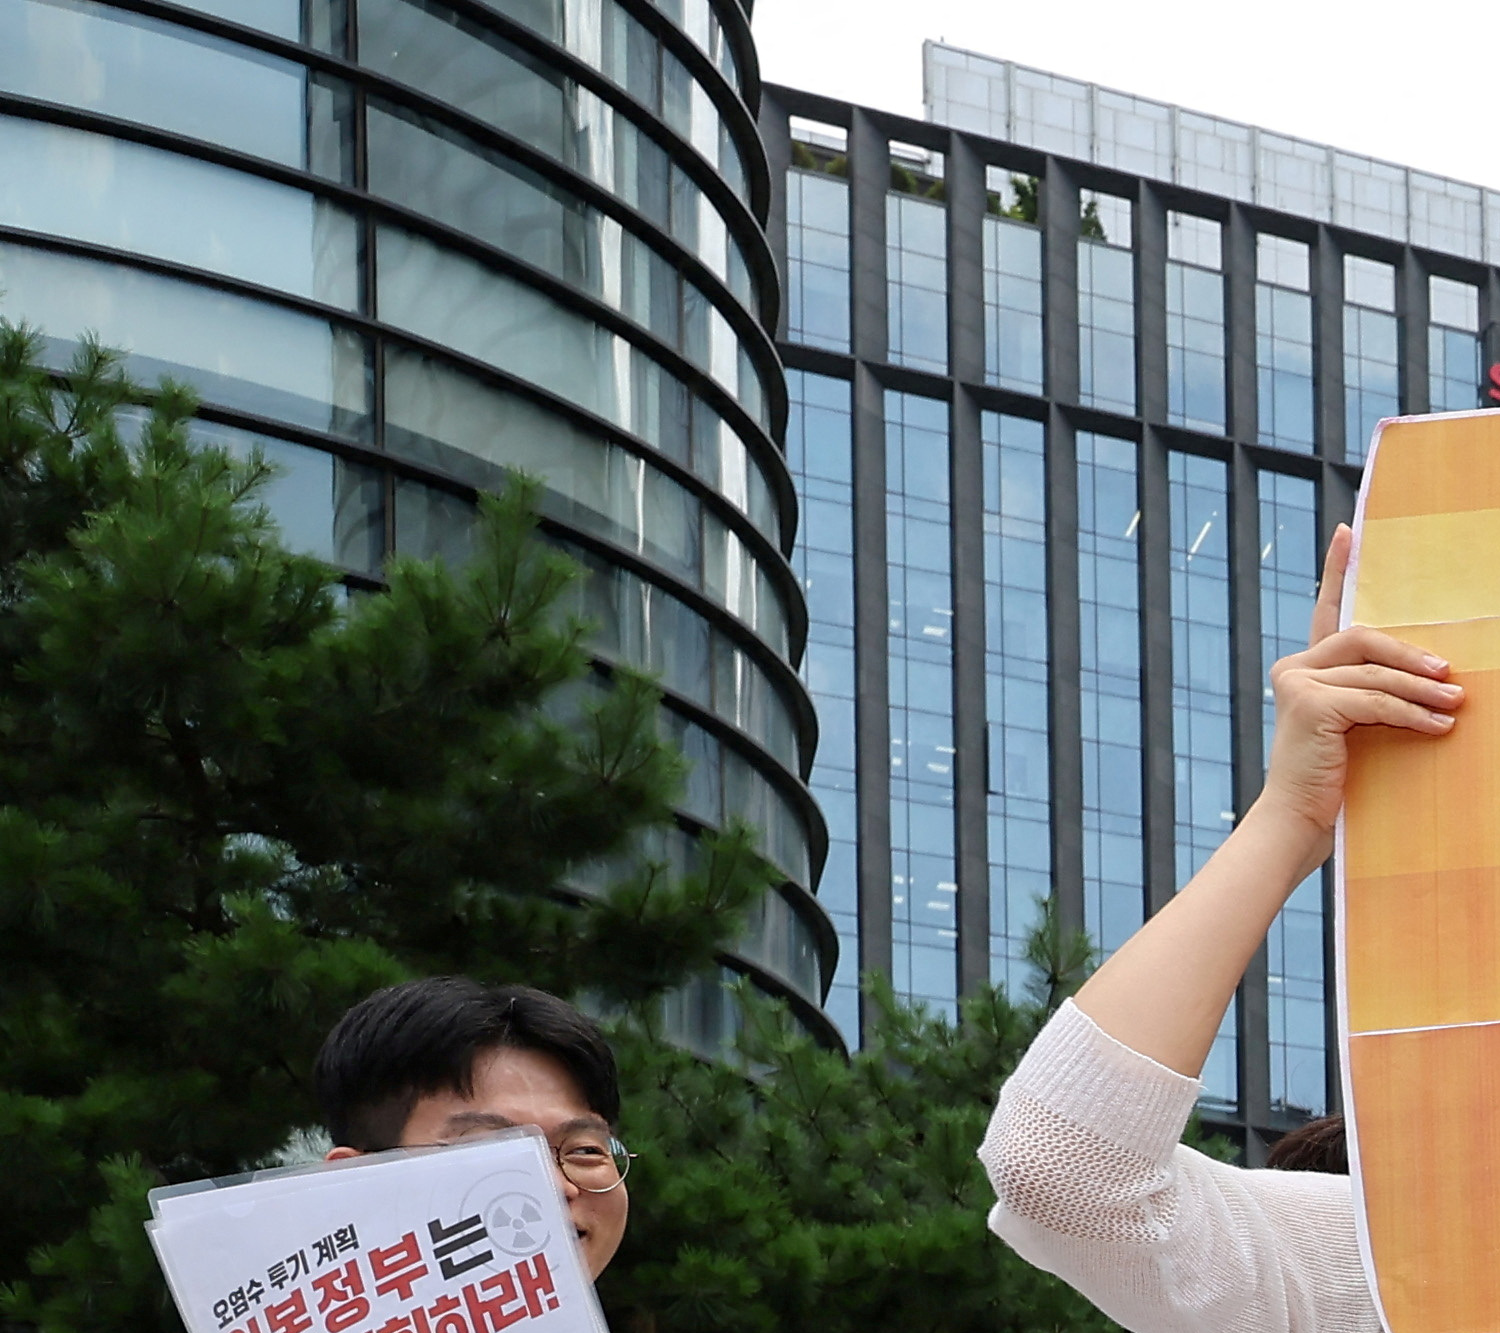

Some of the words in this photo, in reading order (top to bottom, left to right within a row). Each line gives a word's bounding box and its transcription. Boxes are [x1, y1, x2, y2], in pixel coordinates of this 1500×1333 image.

[213, 1278, 266, 1330] 오염수
[267, 1249, 310, 1290] 투기
[312, 1223, 360, 1268] 계획
